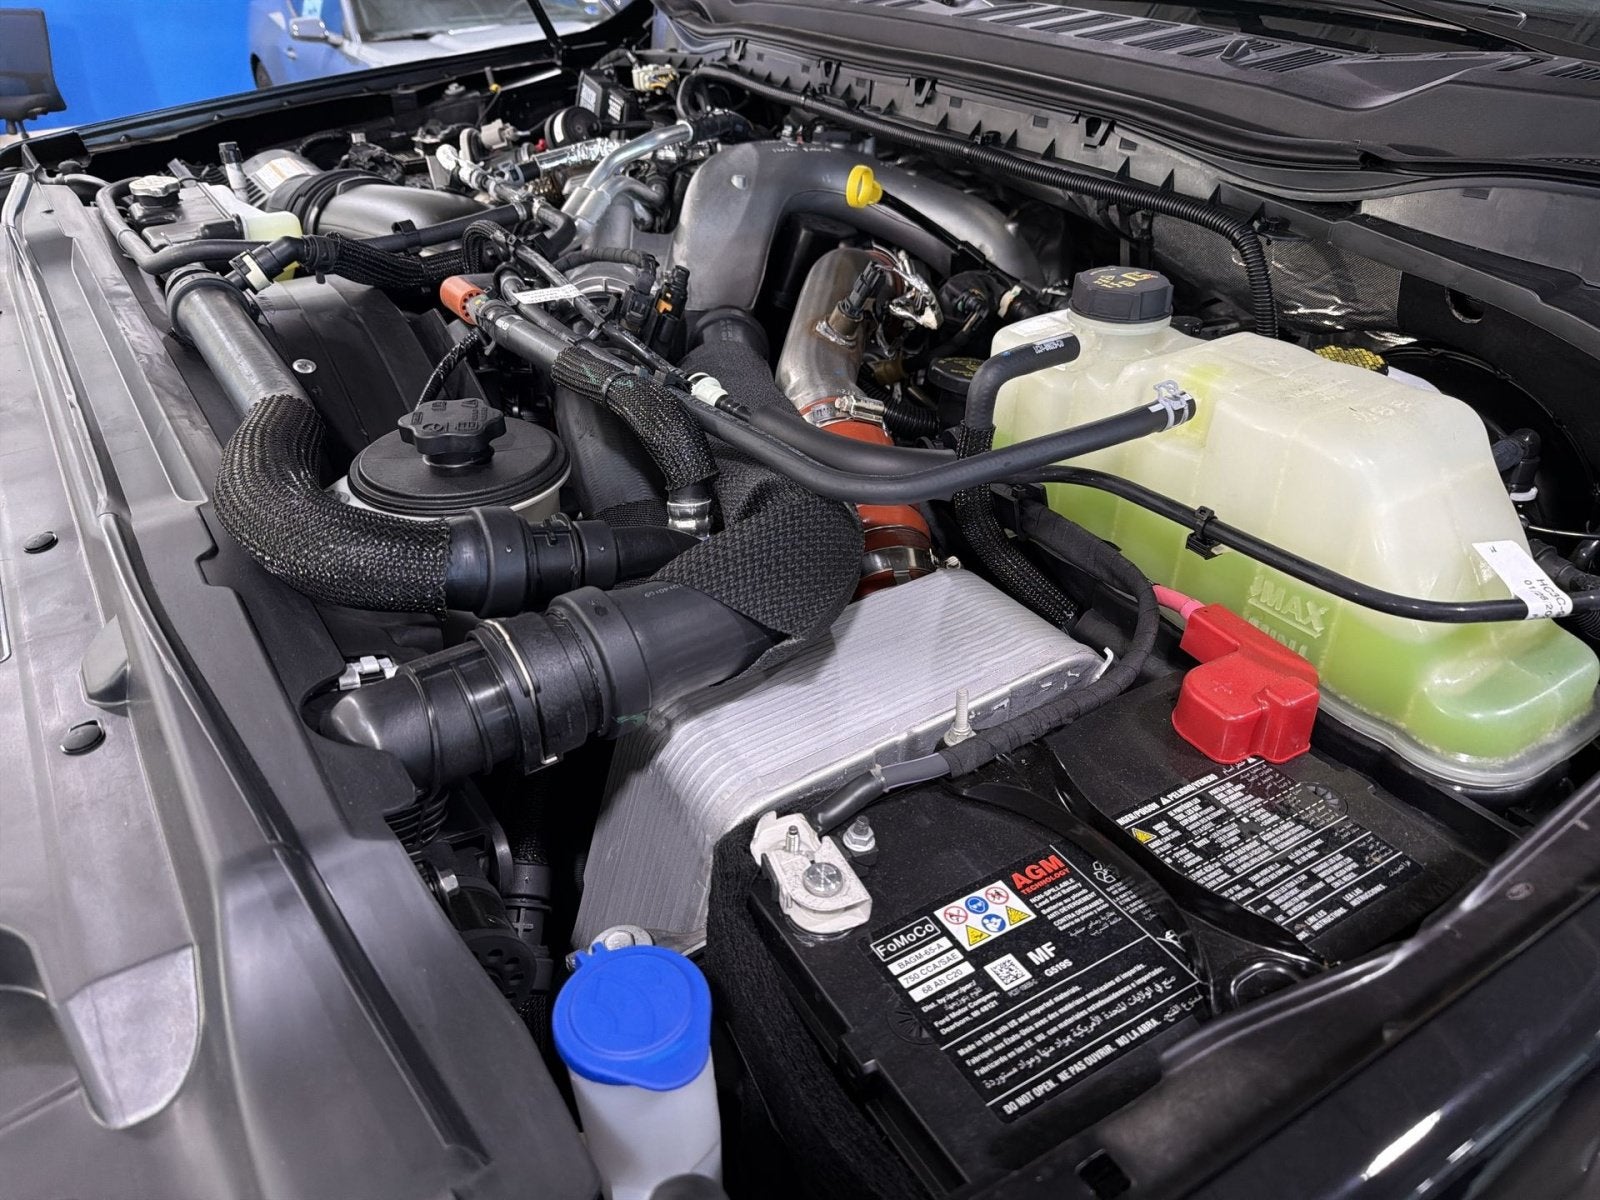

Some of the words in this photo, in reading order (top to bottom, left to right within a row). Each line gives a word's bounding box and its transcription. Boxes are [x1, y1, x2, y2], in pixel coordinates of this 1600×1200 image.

[1115, 801, 1160, 825] NGER/POISON
[1011, 854, 1065, 889] AGM
[1023, 867, 1069, 894] TECHNOLOGY
[1028, 877, 1075, 903] NON-SPILLABLE
[1033, 897, 1050, 908] Lead
[1048, 891, 1062, 901] Acid
[1060, 881, 1082, 894] Battery
[1040, 901, 1063, 914] Batterie
[1069, 888, 1088, 900] plomb
[1052, 912, 1076, 926] CONTRA
[1074, 897, 1104, 915] DERRAMES
[875, 923, 936, 958] FoMoCo
[1026, 941, 1055, 965] MF
[896, 942, 943, 969] BAGM-65-A
[902, 972, 920, 984] 750
[919, 952, 958, 975] CCA/SAE
[1043, 958, 1072, 976] G519S
[921, 984, 933, 993] 68
[933, 978, 946, 988] Ah
[945, 968, 963, 980] C20
[920, 1001, 938, 1012] Dist.
[933, 1015, 951, 1027] Ford
[948, 1005, 968, 1018] Motor
[970, 1009, 981, 1017] MI
[979, 999, 998, 1012] 48121
[956, 1043, 976, 1056] Made
[980, 1031, 996, 1042] USA
[994, 1024, 1009, 1035] with
[1006, 1018, 1018, 1028] US
[1016, 1012, 1029, 1023] and
[1027, 998, 1054, 1016] imported
[1052, 985, 1082, 1002] materials.
[1002, 1100, 1018, 1114] DO
[1014, 1090, 1034, 1106] NOT
[1031, 1078, 1058, 1097] OPEN.
[1056, 1069, 1071, 1081] NE
[1067, 1060, 1086, 1075] PAS
[1082, 1043, 1117, 1066] OUVRIR.
[1114, 1034, 1130, 1047] NO
[1126, 1029, 1140, 1040] LA
[1136, 1017, 1161, 1035] ABRA.
